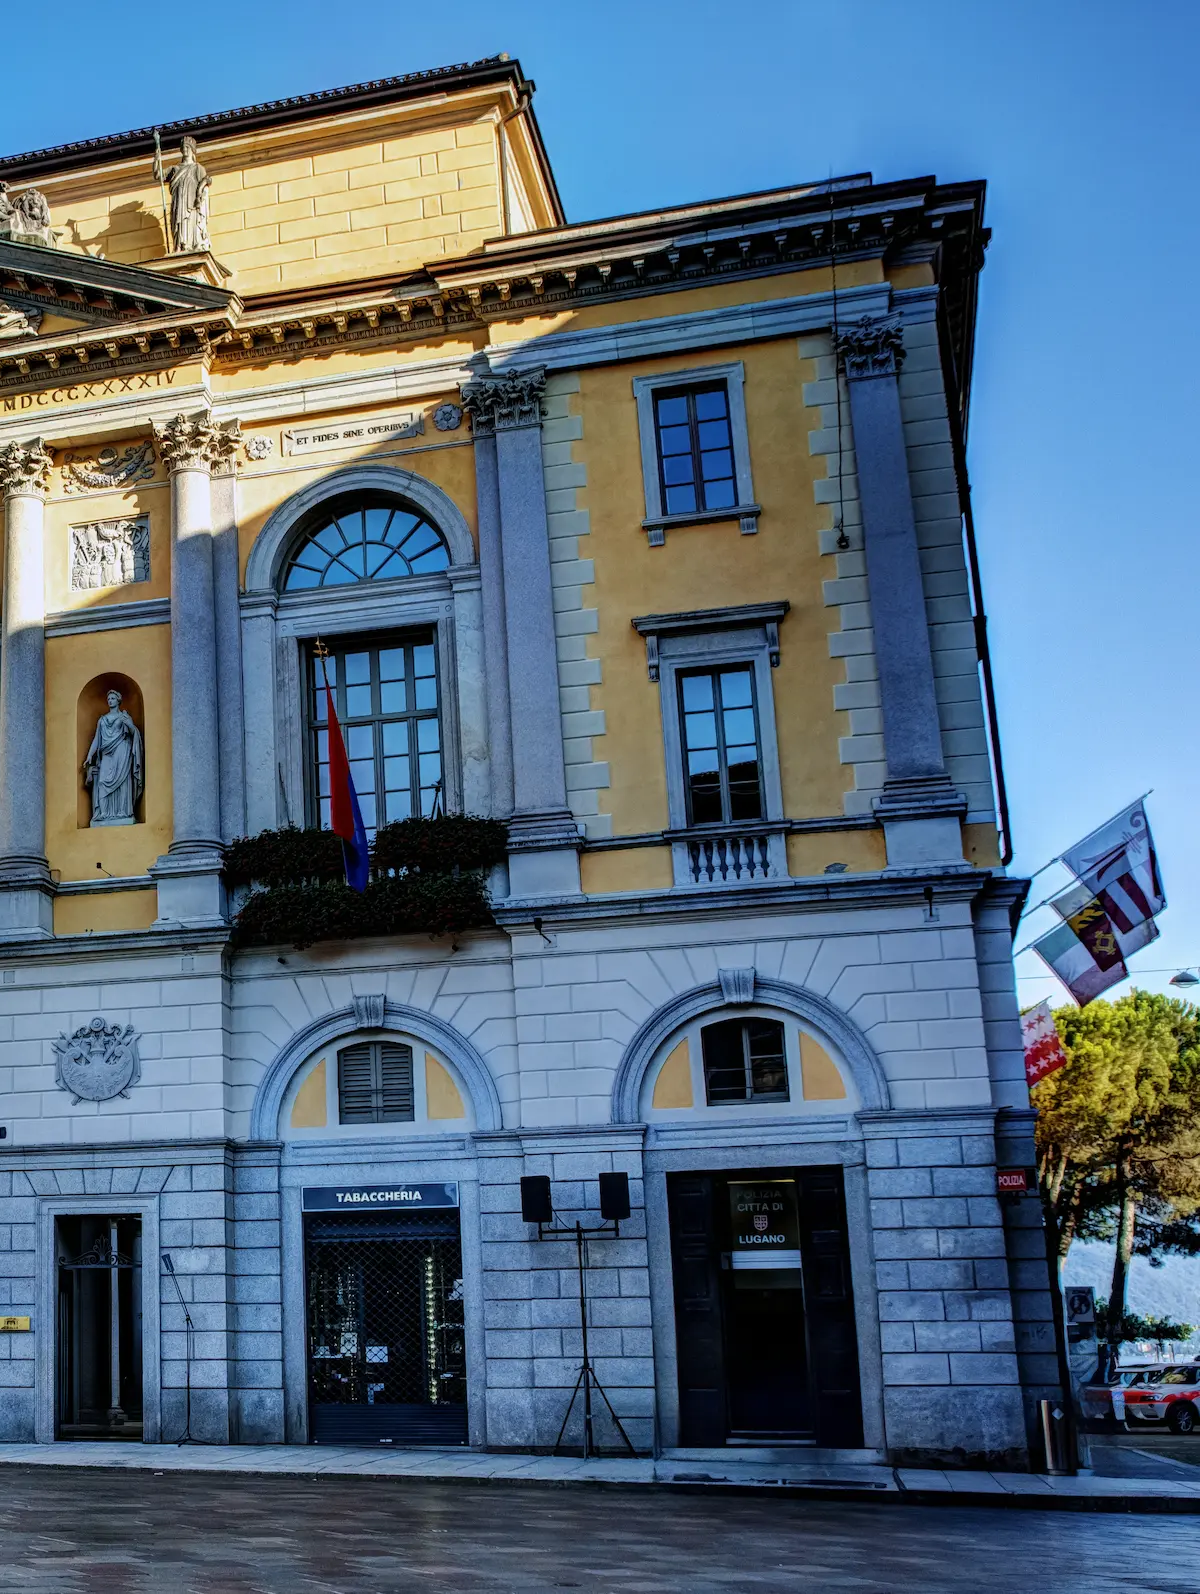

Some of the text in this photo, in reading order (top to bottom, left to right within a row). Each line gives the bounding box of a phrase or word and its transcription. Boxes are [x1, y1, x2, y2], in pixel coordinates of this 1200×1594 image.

[2, 370, 177, 412] MDCCCXXXXIV
[296, 421, 410, 446] ET FIDES SINE OPERIBVS
[998, 1175, 1025, 1186] POLIZIA
[335, 1190, 423, 1203] TABACCHERIA
[736, 1190, 782, 1200] POLIZIA
[772, 1202, 784, 1211] DI
[738, 1234, 786, 1244] LUGANO
